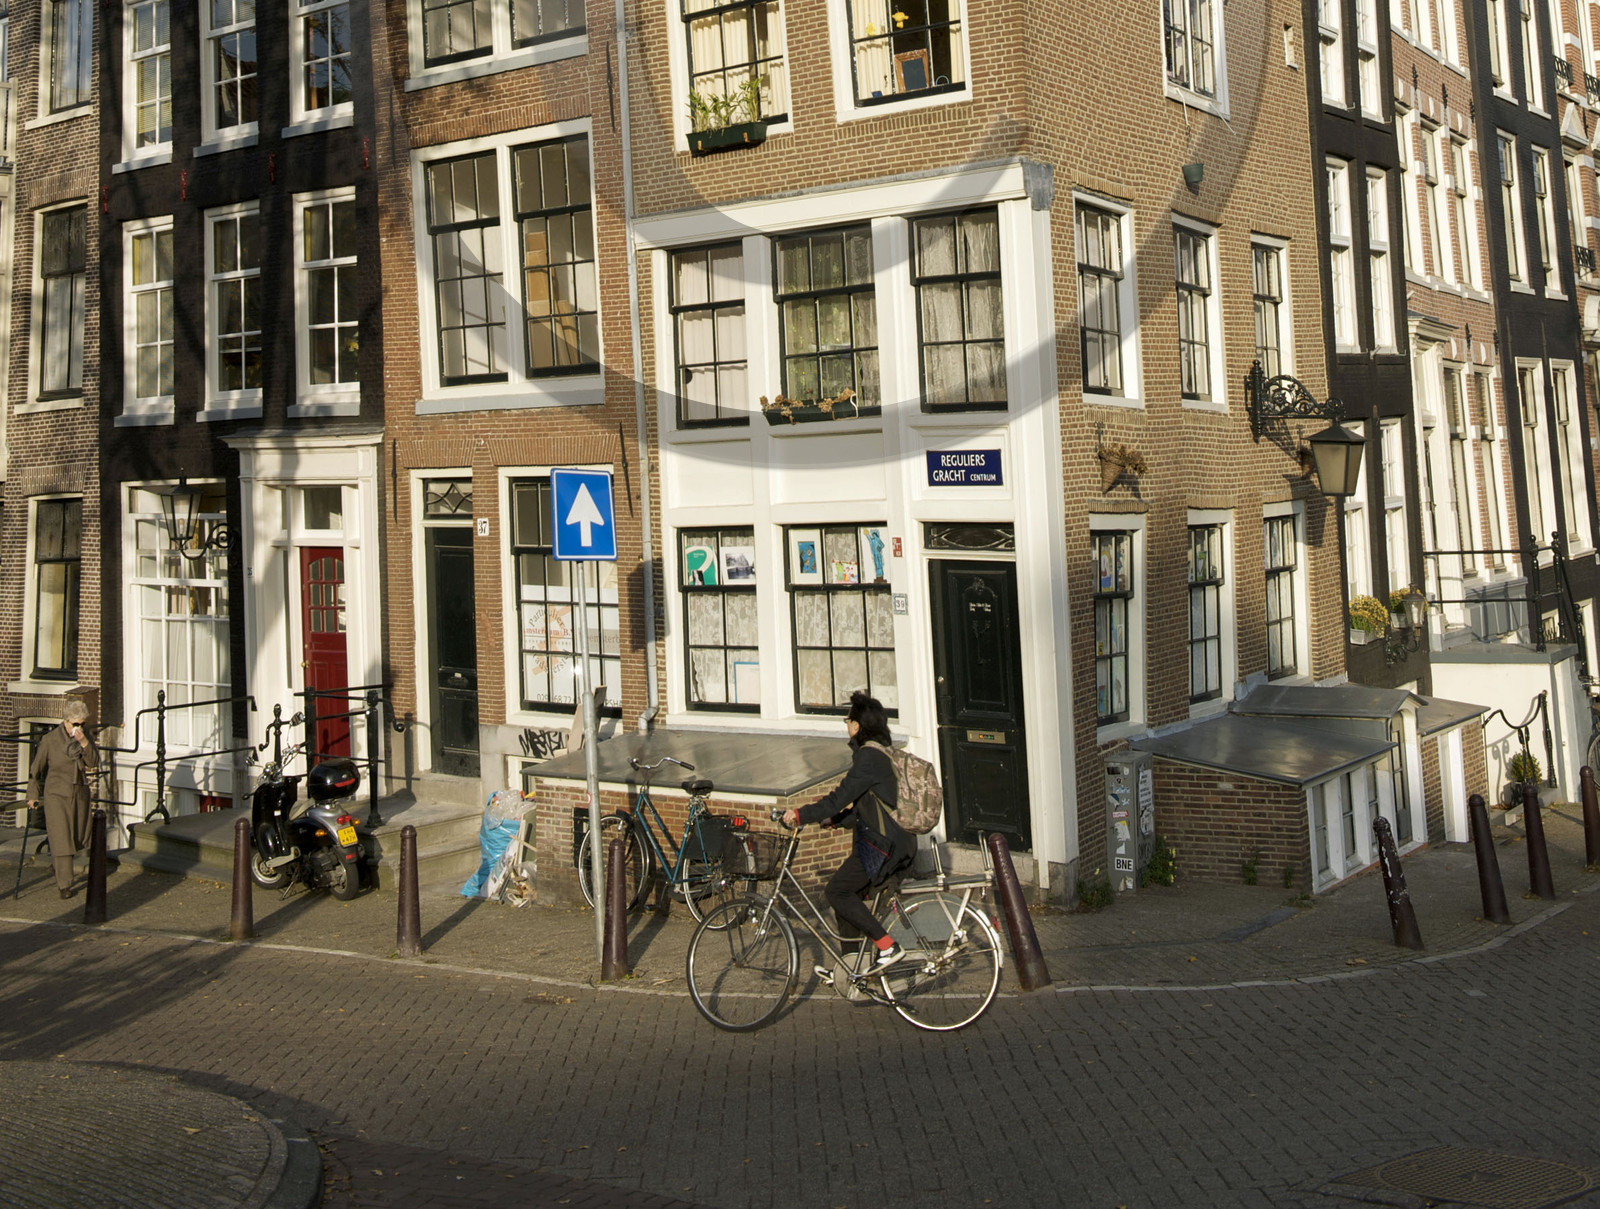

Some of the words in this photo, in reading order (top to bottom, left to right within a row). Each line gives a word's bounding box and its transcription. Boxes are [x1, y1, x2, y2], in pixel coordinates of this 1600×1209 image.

[941, 454, 985, 466] REGULIERS
[933, 469, 966, 482] GRACHT
[970, 474, 997, 482] CENTRUM
[478, 520, 488, 534] 37
[896, 599, 905, 608] 39
[1116, 859, 1132, 870] BNE
